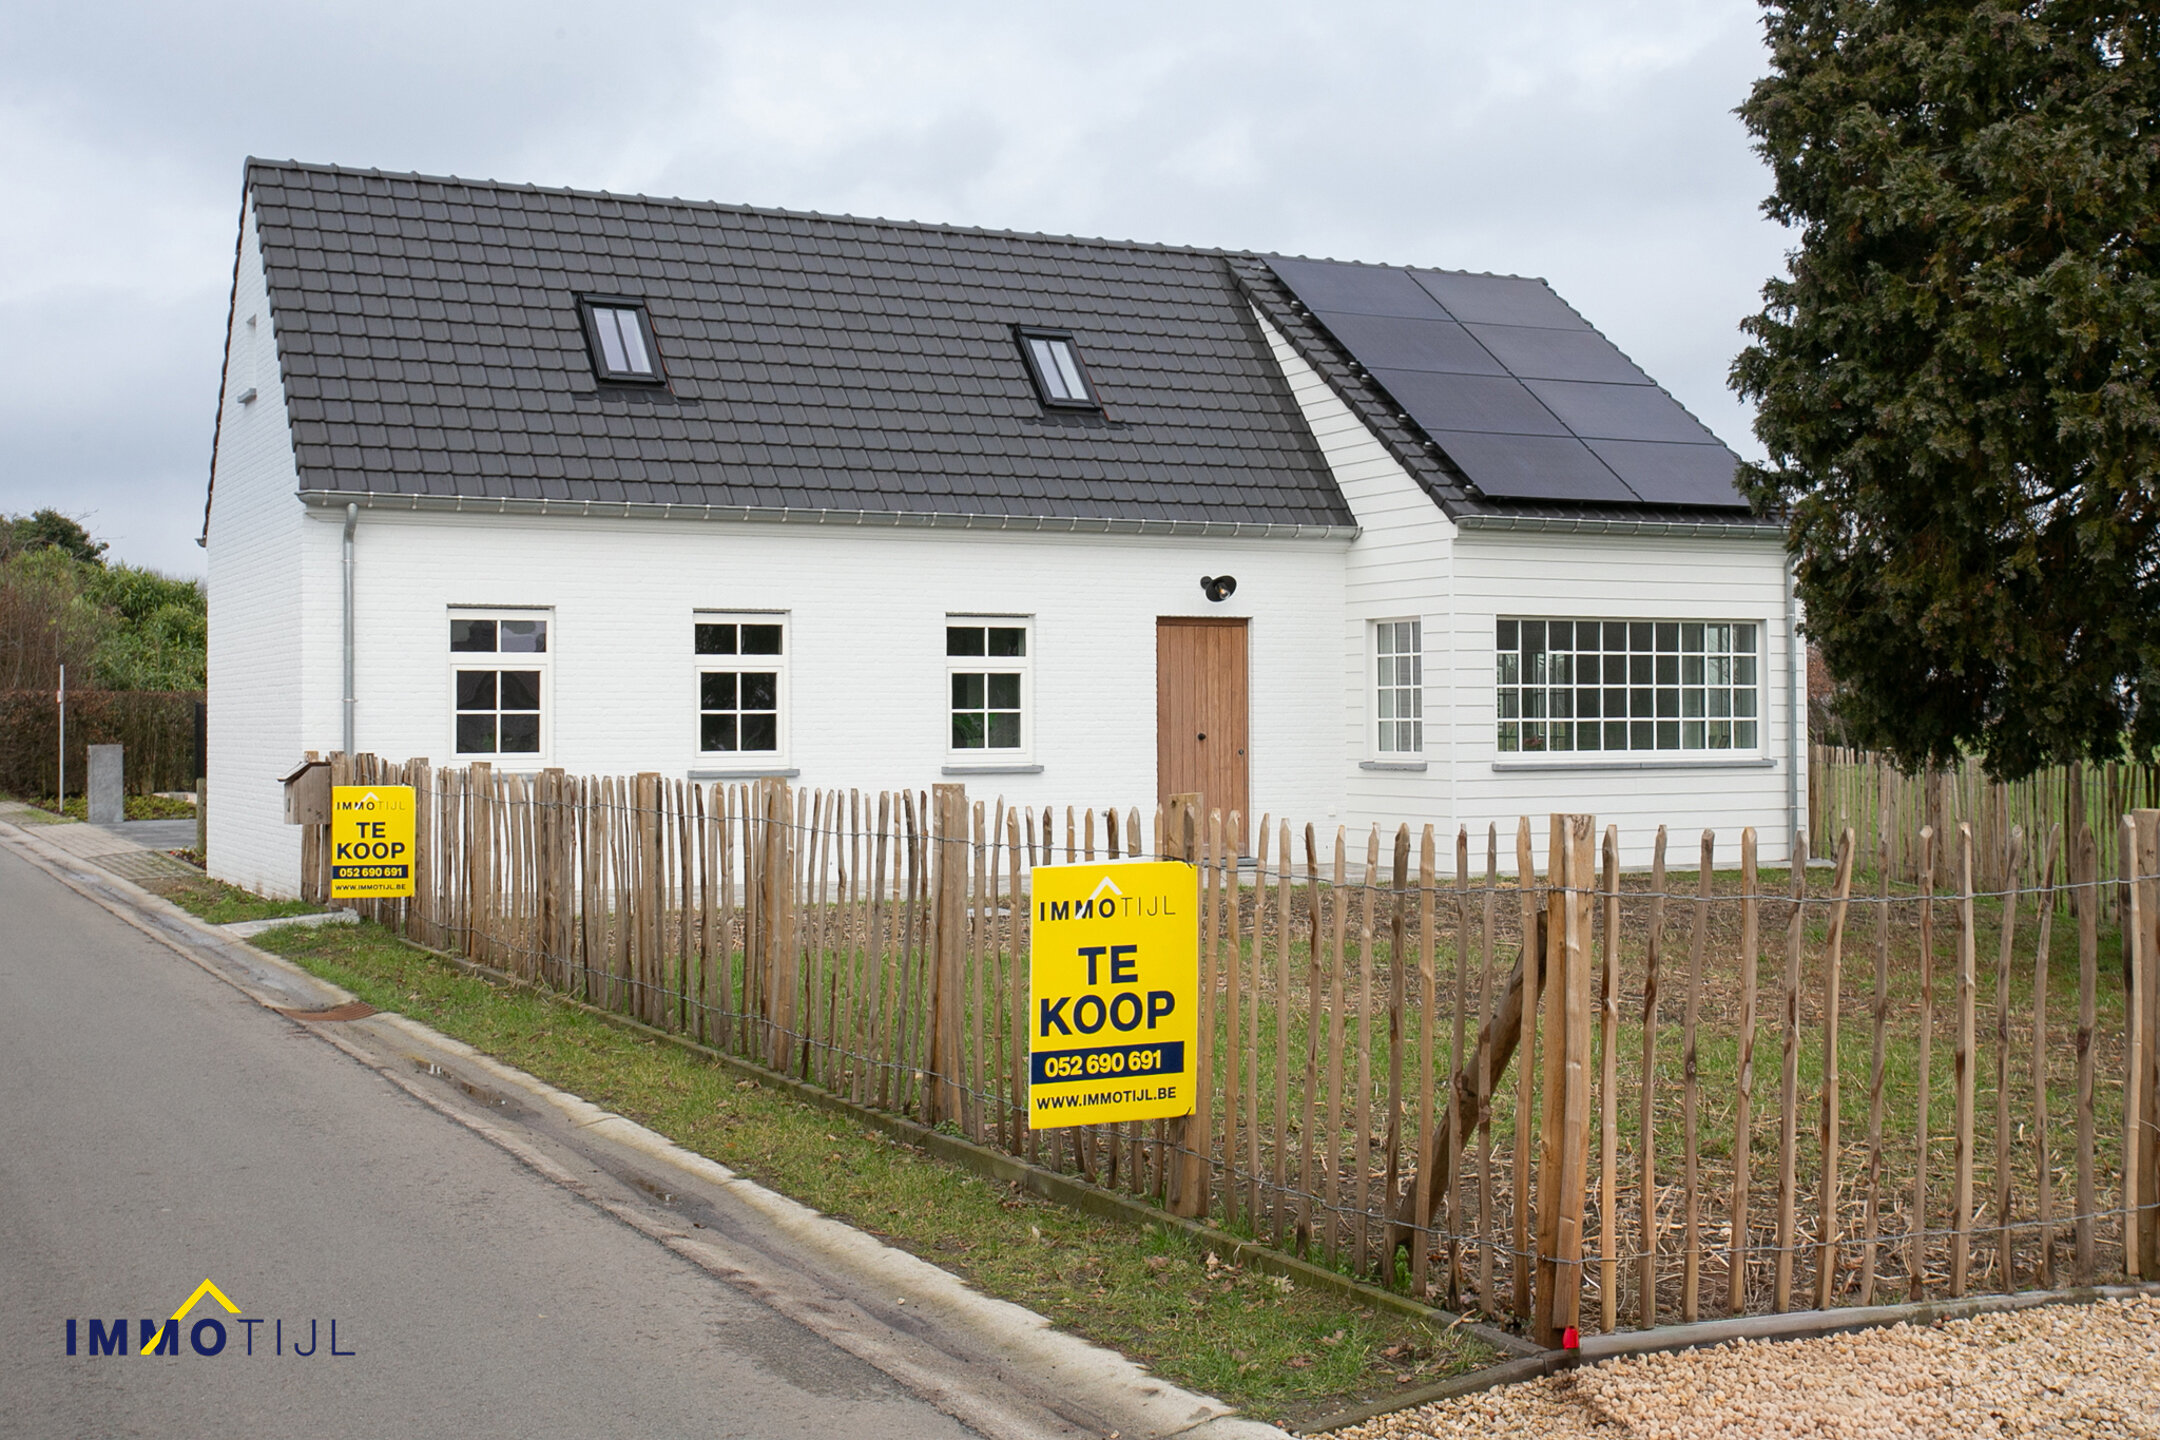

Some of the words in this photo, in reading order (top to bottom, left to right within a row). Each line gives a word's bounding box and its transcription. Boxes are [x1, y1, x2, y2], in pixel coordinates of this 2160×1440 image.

[336, 801, 406, 811] IMMOTIJL
[356, 822, 386, 838] TE
[337, 842, 405, 859] KOOP
[339, 867, 360, 877] 052
[361, 867, 382, 877] 690
[384, 867, 402, 877] 691
[1040, 896, 1176, 921] IMMOTIJL
[1078, 944, 1138, 985] TE
[1040, 991, 1175, 1037] KOOP
[1044, 1055, 1083, 1078] 052
[1086, 1052, 1125, 1075] 690
[1127, 1049, 1161, 1071] 691
[1037, 1086, 1176, 1110] WWW.IMMOTIJL.BE
